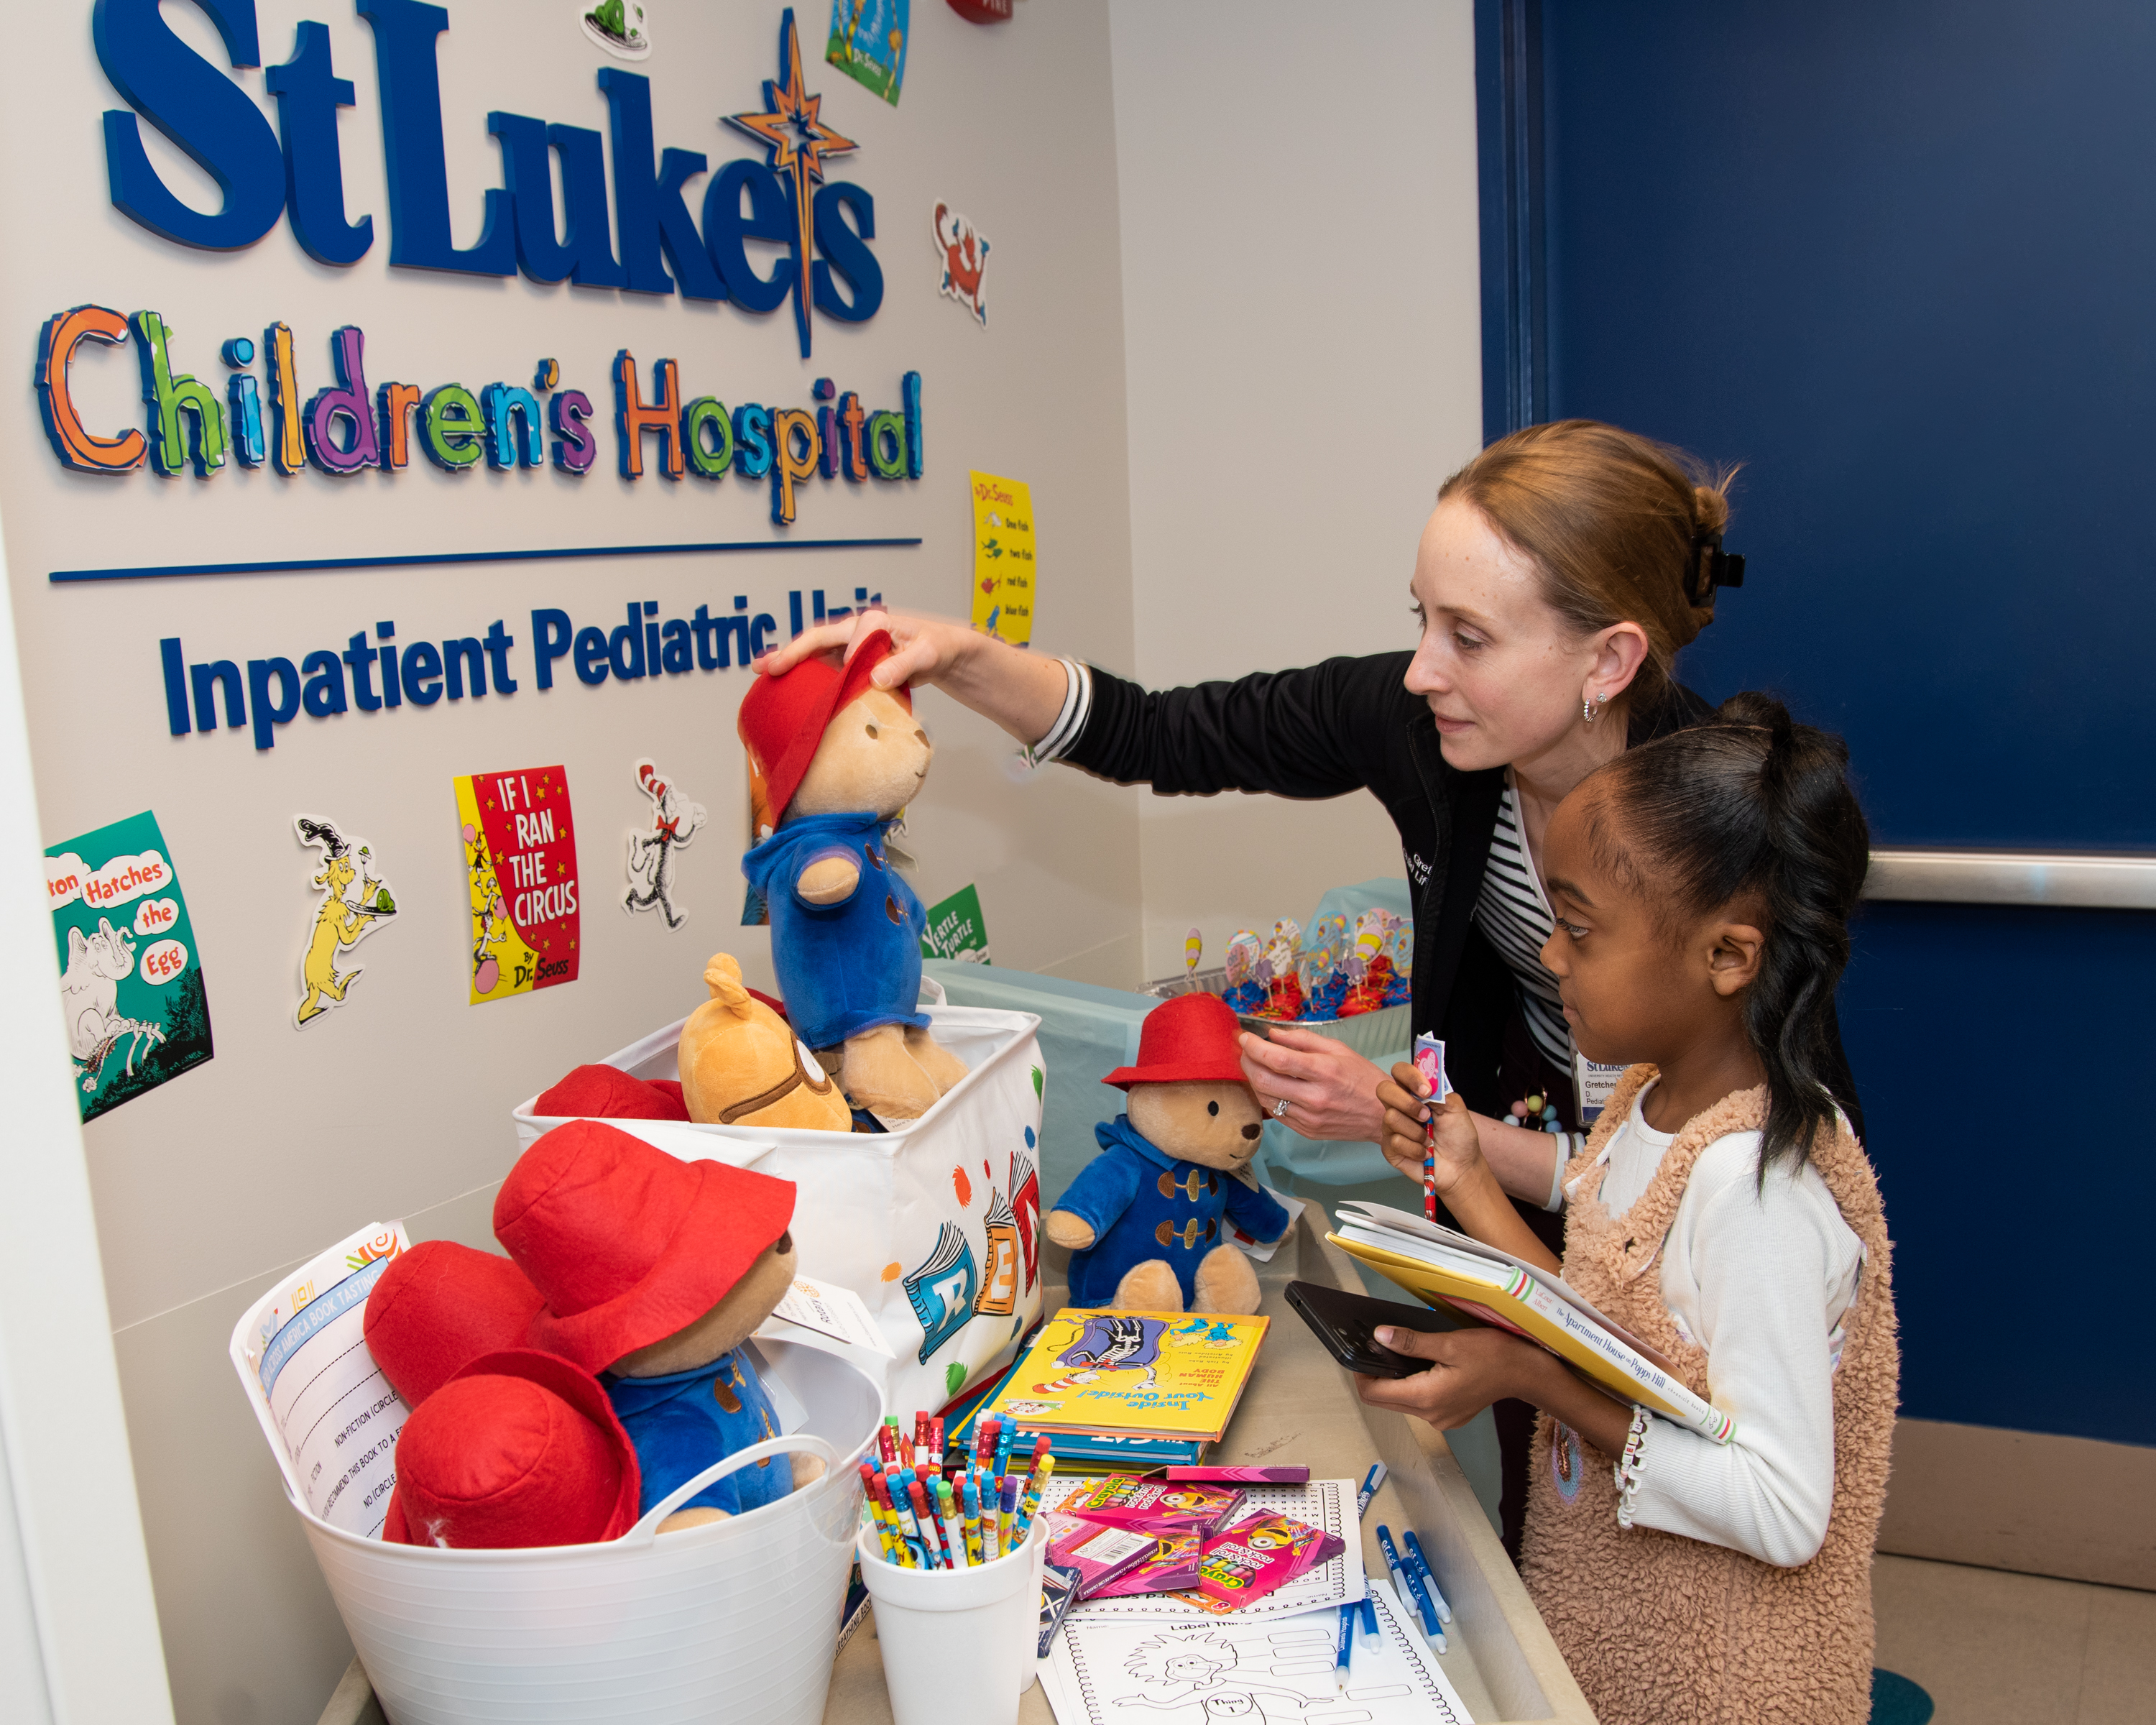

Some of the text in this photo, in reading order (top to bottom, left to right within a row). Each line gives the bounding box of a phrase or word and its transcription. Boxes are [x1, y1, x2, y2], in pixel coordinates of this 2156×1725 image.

[34, 304, 923, 526] Children's Hospital
[992, 484, 1013, 507] Seuss
[1005, 518, 1028, 532] One fish
[1010, 548, 1033, 561] two fish
[1007, 576, 1028, 588] red fish
[1005, 604, 1028, 617] blue fish
[160, 619, 517, 750] Inpatient
[531, 595, 778, 690] Pediatric
[497, 775, 530, 812] IF I
[515, 808, 556, 850] RAN
[86, 861, 163, 903] Hatches
[508, 851, 548, 888] THE
[514, 879, 578, 927] CIRCUS
[142, 904, 172, 929] the
[921, 910, 959, 957] YERTLE
[941, 917, 974, 960] TURTLE
[145, 946, 183, 978] Egg
[523, 951, 535, 965] By
[513, 957, 569, 989] Dr. Seuss
[809, 1297, 833, 1325] Rotary
[1532, 1298, 1549, 1312] Albert
[265, 1345, 285, 1377] ACROSS
[280, 1317, 311, 1355] AMERICA
[308, 1297, 338, 1327] BOOK
[336, 1269, 380, 1306] TASTING
[1556, 1307, 1565, 1317] The
[1563, 1312, 1603, 1347] Apartment
[1602, 1338, 1626, 1362] House
[1631, 1357, 1653, 1382] Poppy
[1652, 1371, 1667, 1389] Hill
[1667, 1386, 1690, 1404] chronicle
[1691, 1399, 1705, 1414] books
[1076, 1389, 1159, 1402] Outside!
[1126, 1400, 1190, 1411] Inside
[1164, 1392, 1214, 1402] Your
[333, 1390, 399, 1448] NON-FICTION (CIRCLE
[310, 1460, 323, 1484] FICTION
[326, 1474, 350, 1509] RECOMMEND
[348, 1462, 361, 1479] THIS
[359, 1446, 379, 1468] BOOK
[377, 1438, 389, 1452] TO
[390, 1433, 396, 1444] A
[363, 1473, 397, 1509] NO (CIRCLE
[1085, 1477, 1125, 1508] Crayola
[1125, 1484, 1155, 1509] rock&roll
[1138, 1484, 1168, 1510] rock&roll
[1210, 1548, 1265, 1570] rock&roll
[1220, 1542, 1275, 1564] rock&roll
[1109, 1569, 1124, 1580] CRAYONS
[1083, 1583, 1098, 1596] CRAYOLA
[1212, 1601, 1230, 1611] 8
[1170, 1622, 1210, 1632] Label
